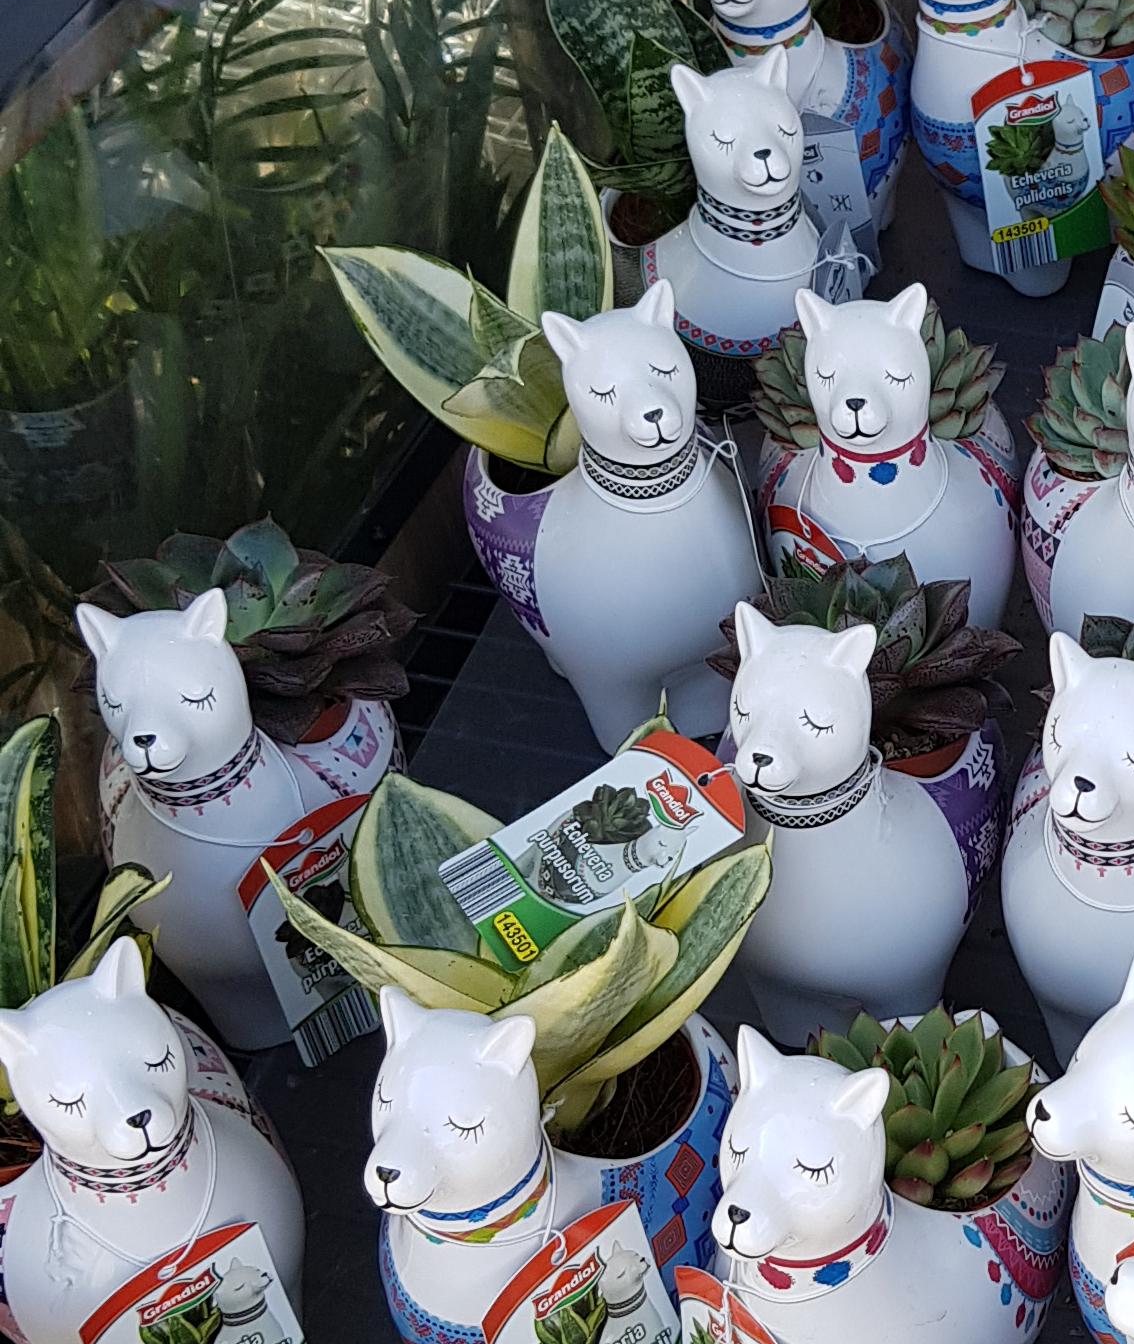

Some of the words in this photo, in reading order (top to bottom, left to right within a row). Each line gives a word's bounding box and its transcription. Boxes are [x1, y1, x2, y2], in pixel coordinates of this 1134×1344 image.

[1009, 101, 1054, 119] Grandiol
[1011, 162, 1072, 189] Echeveria
[1015, 182, 1073, 211] pulidonis
[999, 220, 1044, 241] 143501
[650, 779, 691, 826] Grandiol
[288, 847, 341, 889] Grandiol
[528, 829, 596, 905] purpusorum
[563, 820, 614, 884] Echeveria
[496, 914, 540, 961] 143501
[143, 1276, 211, 1320] Grandiol
[537, 1262, 596, 1313] Grandiol
